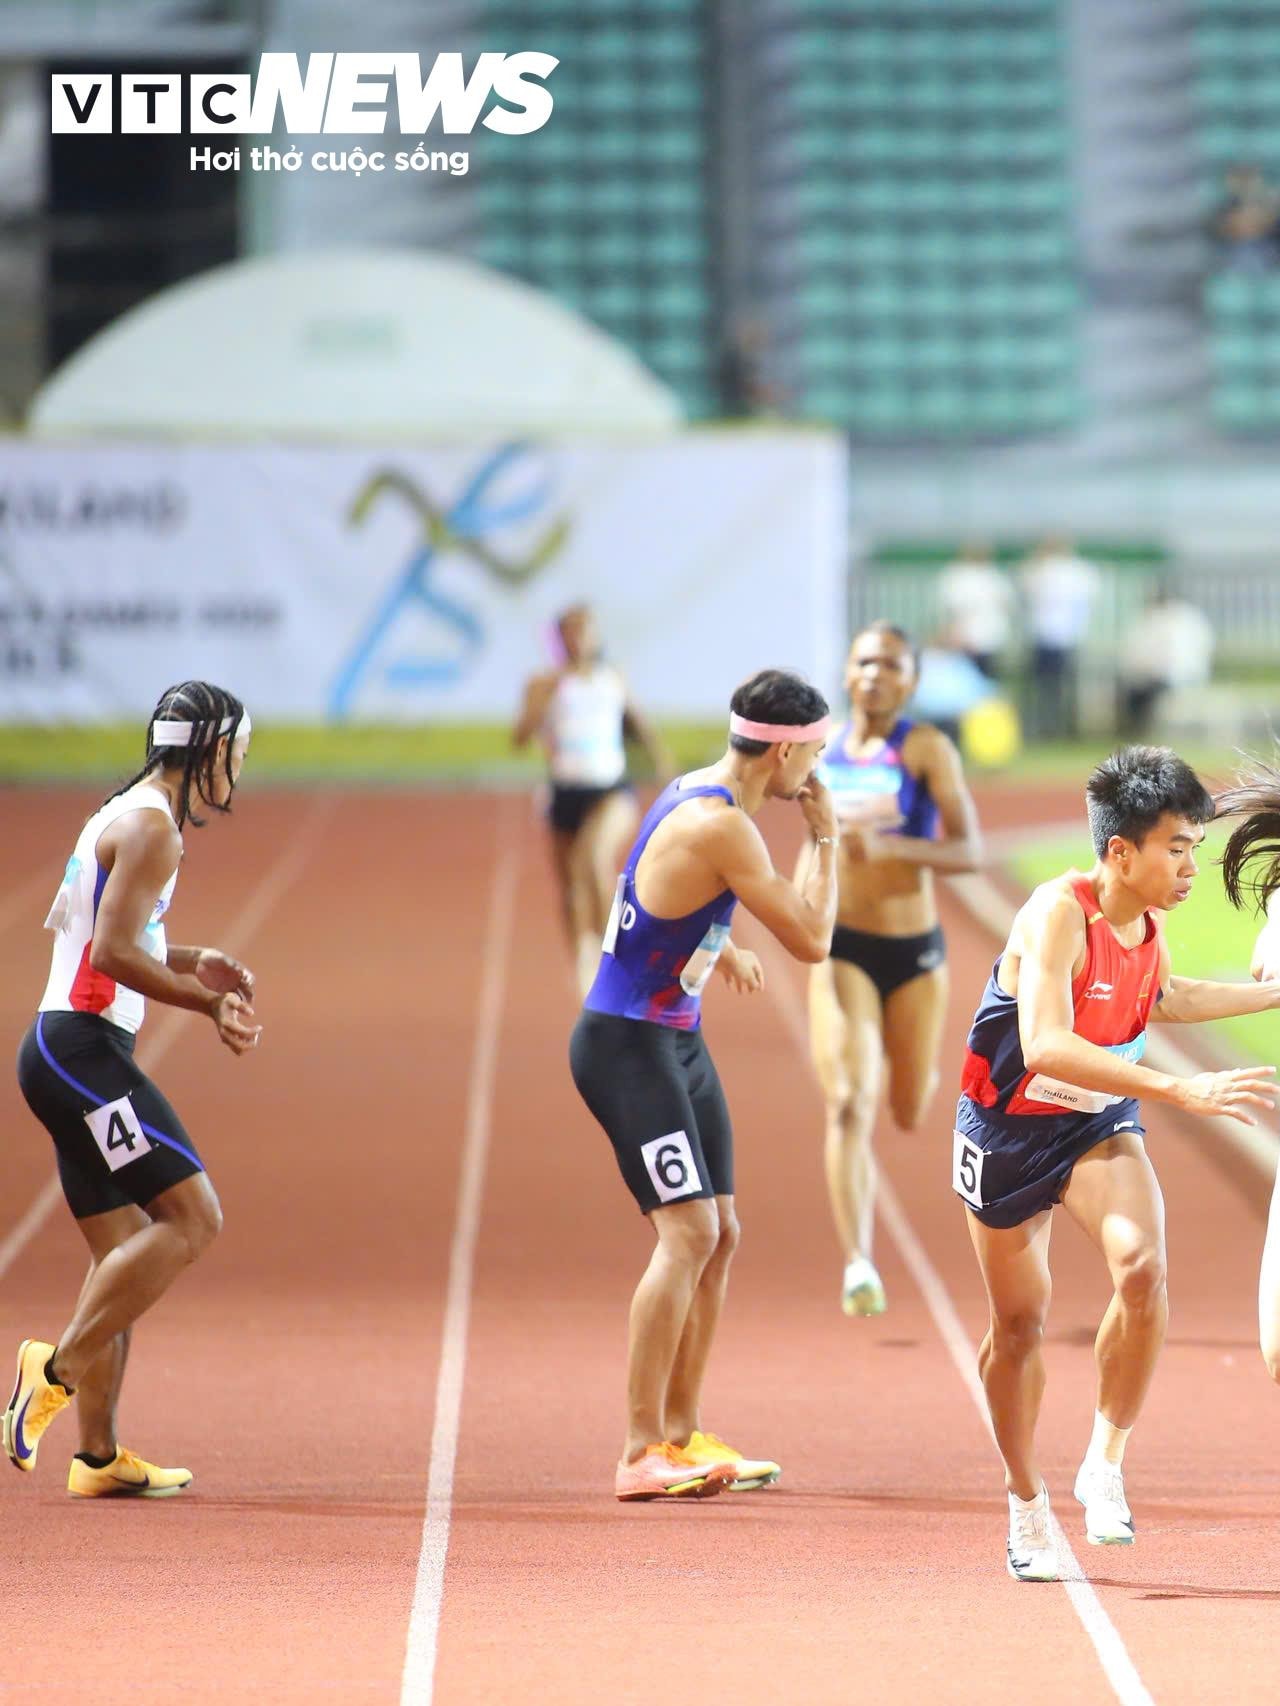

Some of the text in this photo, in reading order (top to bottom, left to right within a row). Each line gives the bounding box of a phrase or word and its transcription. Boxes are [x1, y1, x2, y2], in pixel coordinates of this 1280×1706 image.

[1042, 1089, 1078, 1103] THAILAND
[107, 1109, 136, 1152] 4
[655, 1144, 688, 1189] 6
[959, 1144, 978, 1194] 5
